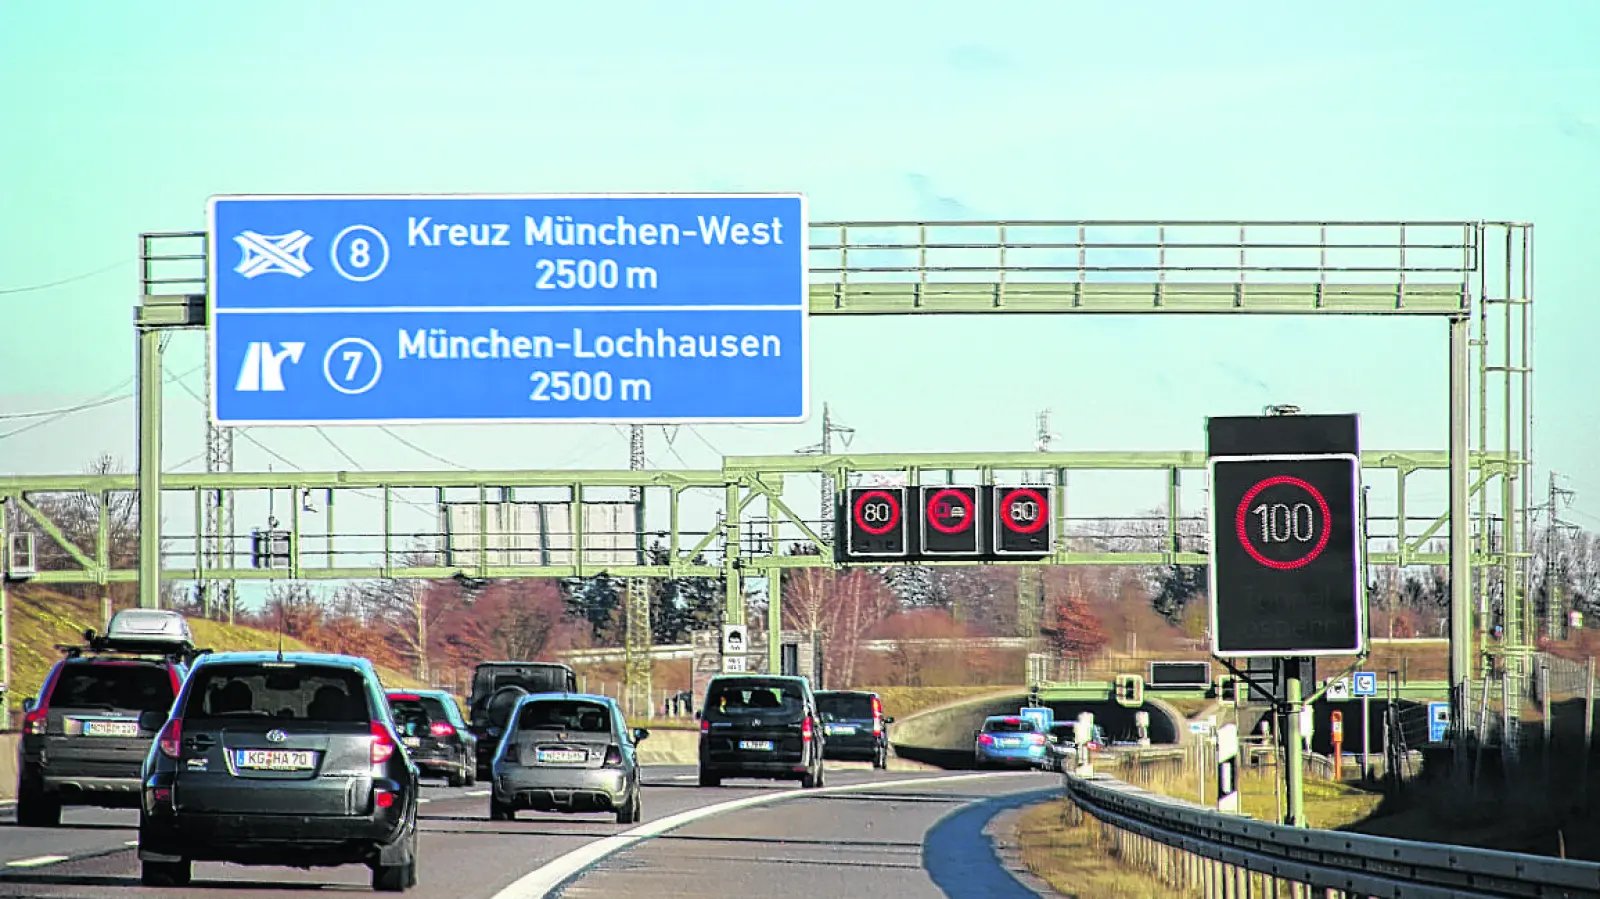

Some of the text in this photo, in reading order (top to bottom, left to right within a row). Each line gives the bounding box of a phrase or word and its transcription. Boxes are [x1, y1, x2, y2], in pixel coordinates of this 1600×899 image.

[408, 215, 783, 246] Kreuz München-West
[349, 239, 370, 268] 8
[536, 259, 657, 289] 2500 m
[398, 328, 781, 359] München-Lochhausen
[343, 351, 363, 381] 7
[531, 370, 651, 401] 2500 m
[864, 503, 889, 522] 80
[1252, 503, 1313, 543] 100
[248, 752, 265, 764] KG
